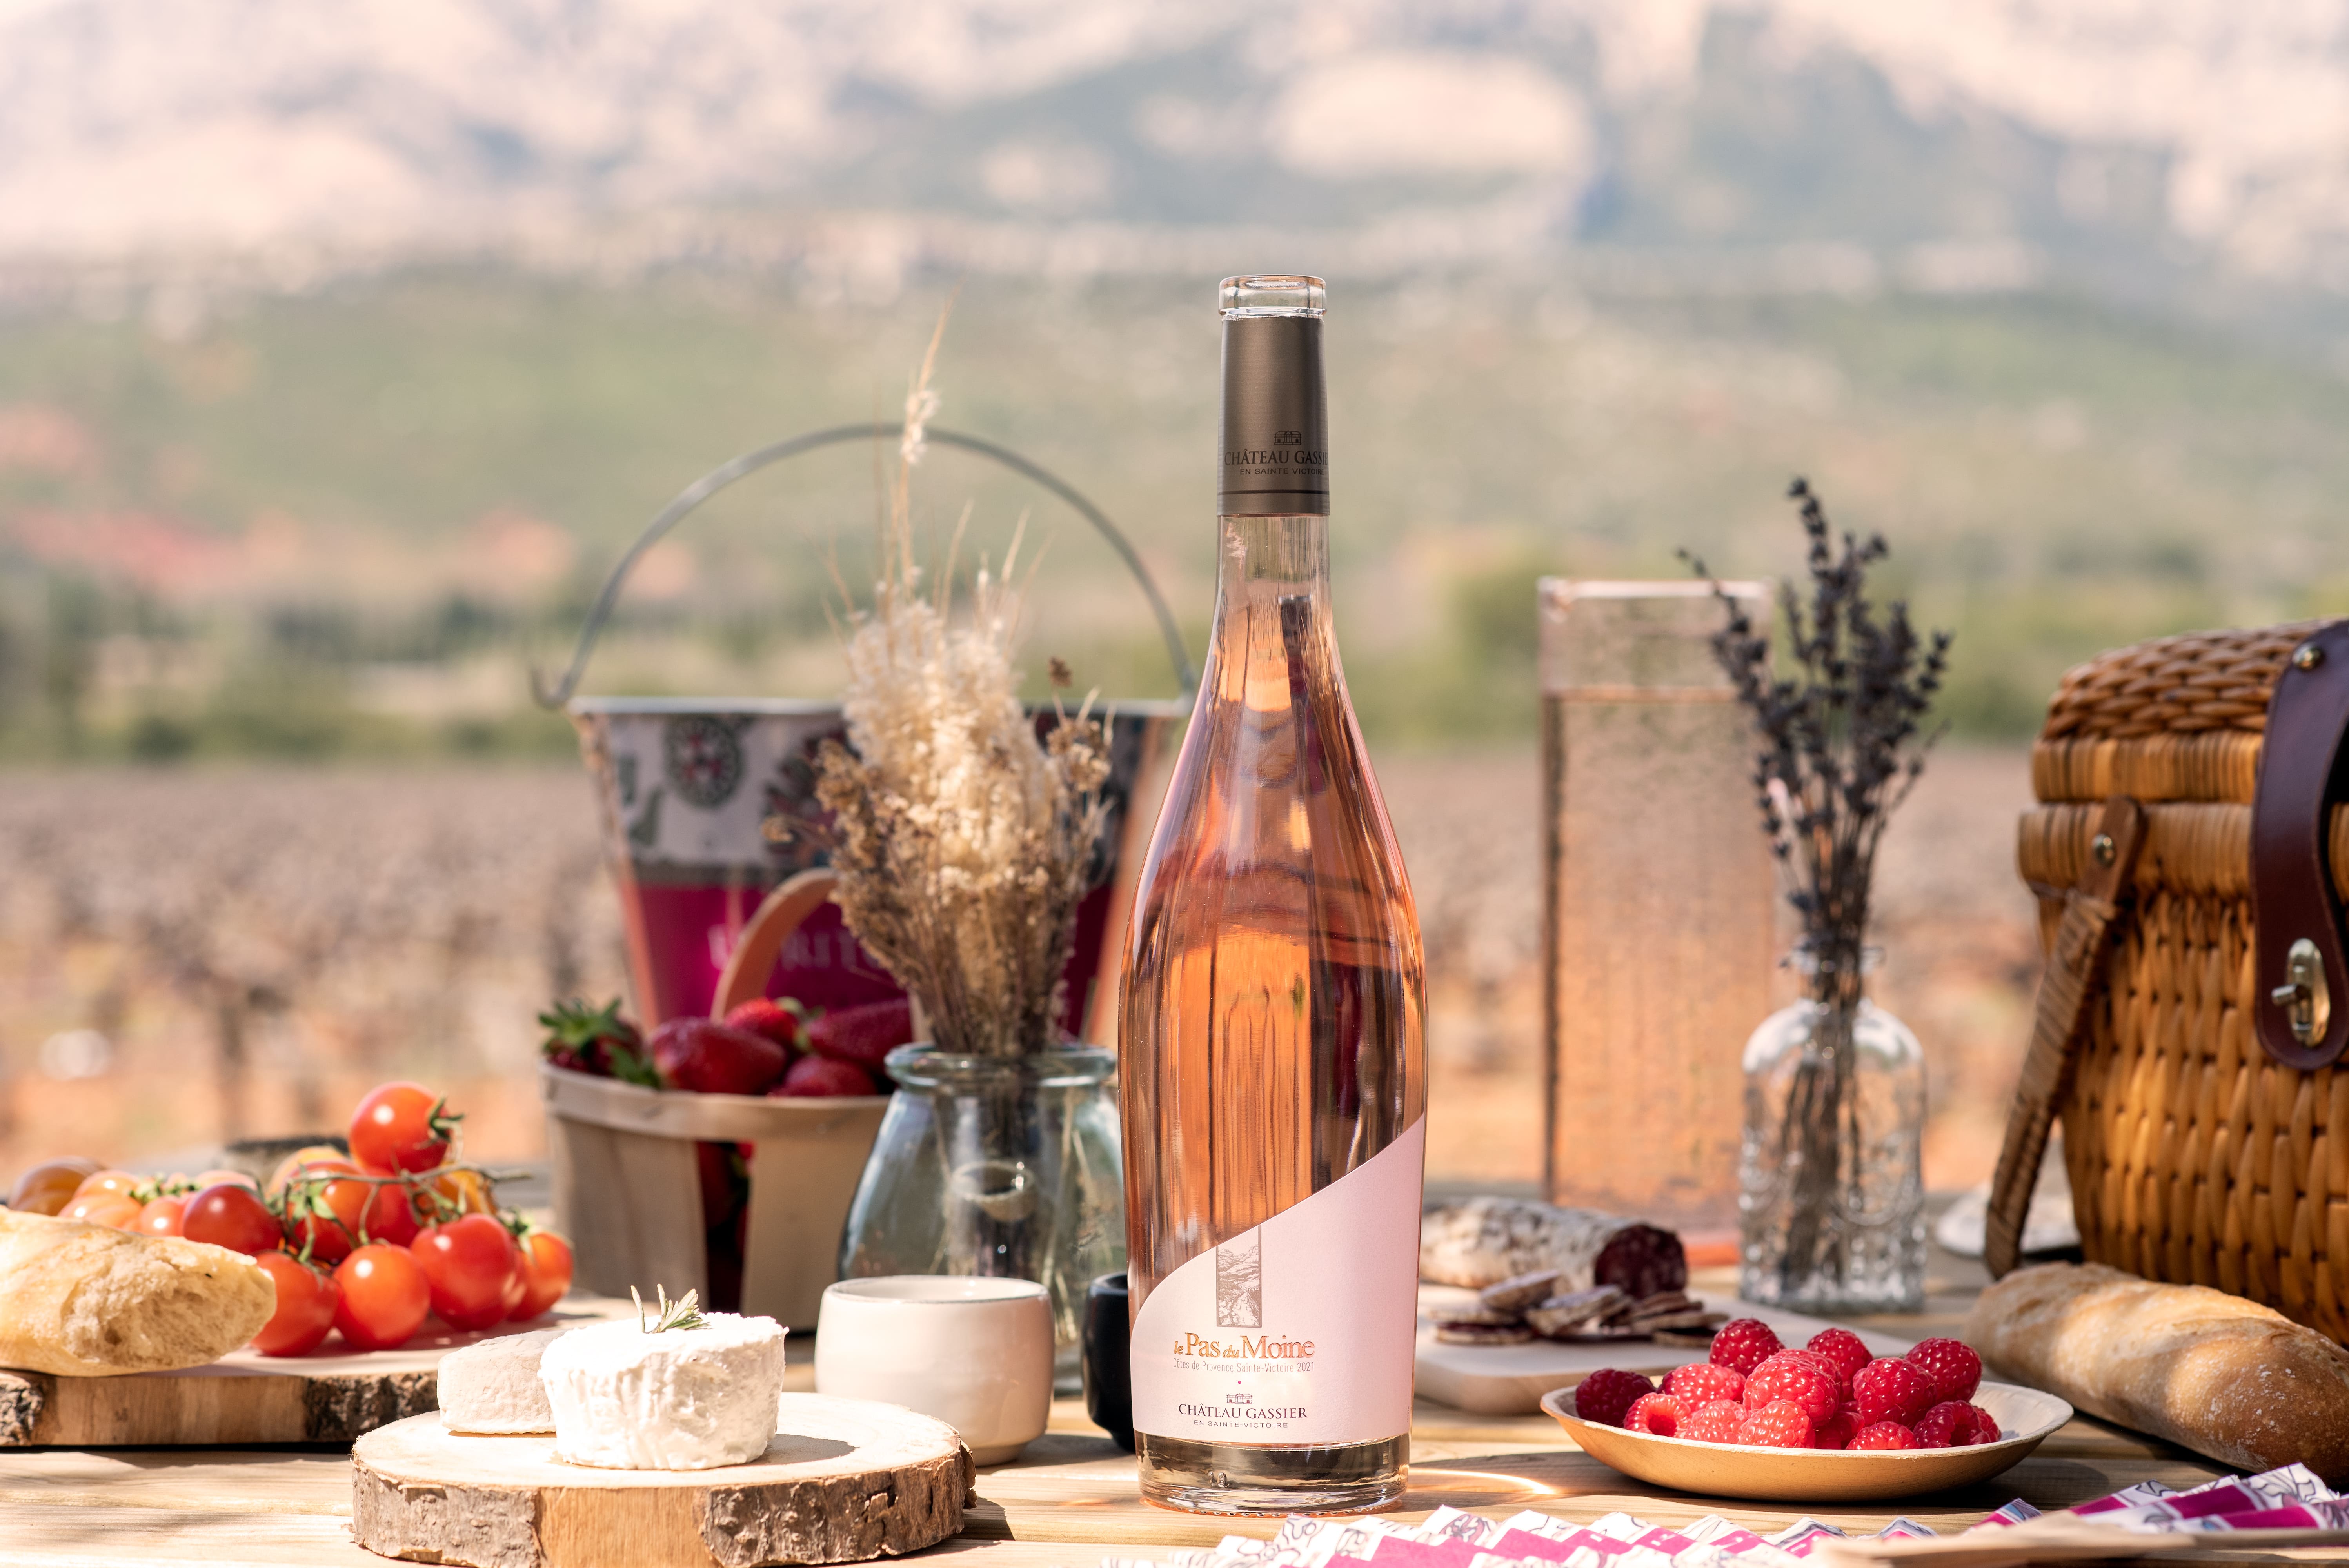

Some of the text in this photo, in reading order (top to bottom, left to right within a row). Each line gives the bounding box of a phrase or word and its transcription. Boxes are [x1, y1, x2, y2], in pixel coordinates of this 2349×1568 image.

[1224, 449, 1290, 465] CHÂTEAU
[1174, 1332, 1315, 1359] le Pas du Moine
[1173, 1358, 1314, 1373] Côtes de Provence Sainte-Victoire 2021
[1179, 1403, 1308, 1419] CHÂTEAU GASSIER
